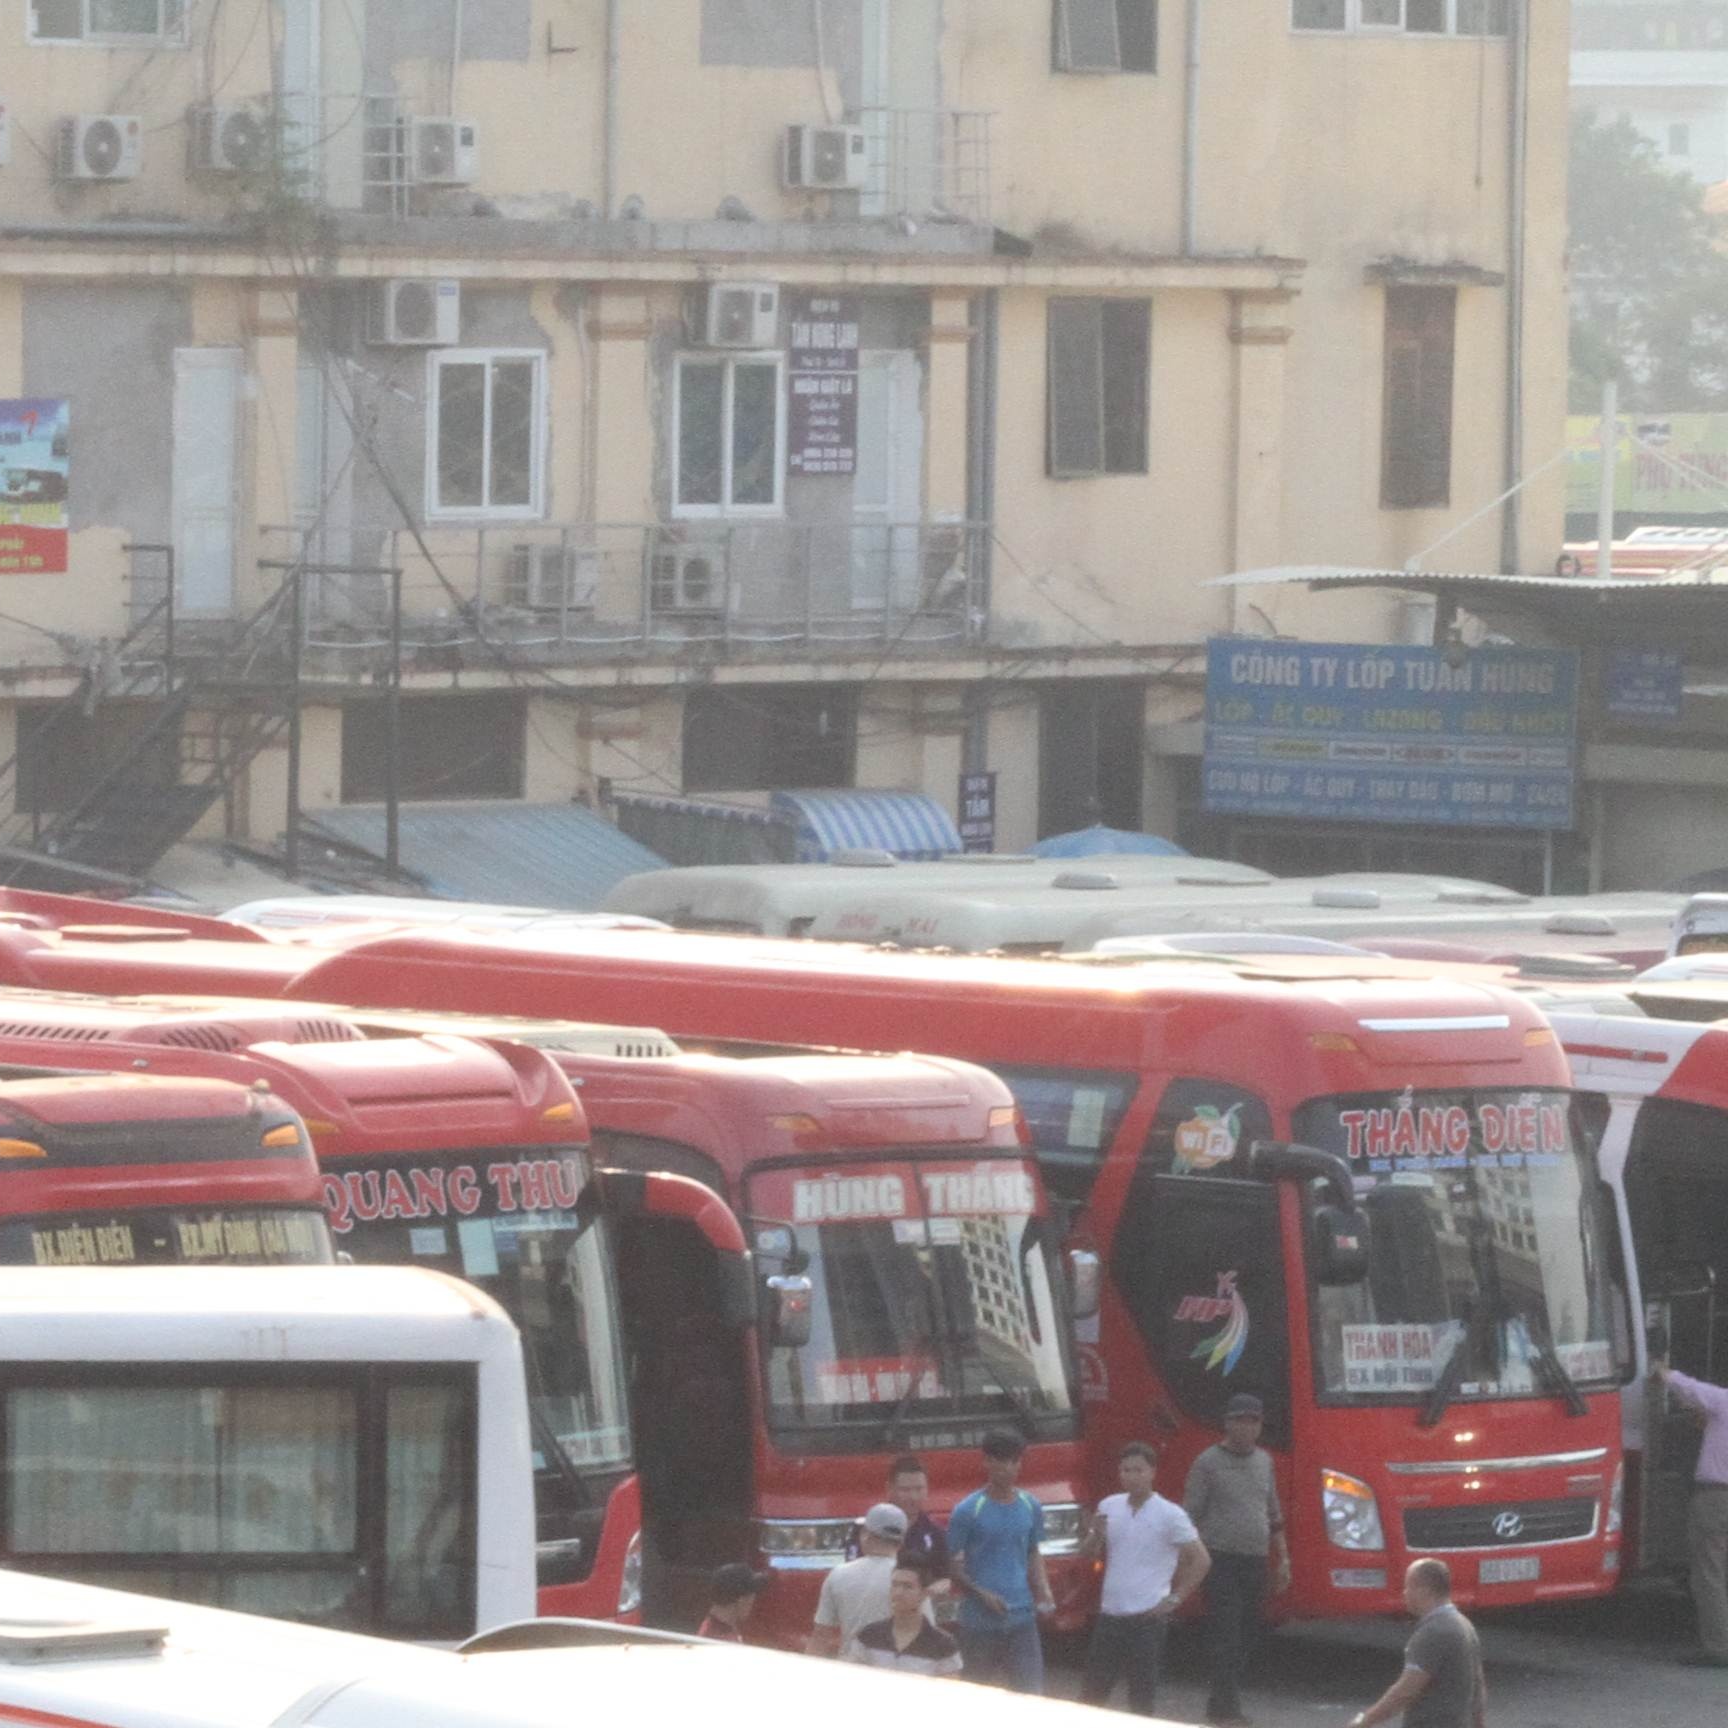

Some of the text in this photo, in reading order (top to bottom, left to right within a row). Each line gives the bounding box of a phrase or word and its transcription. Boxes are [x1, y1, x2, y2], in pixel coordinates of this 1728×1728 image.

[1230, 648, 1301, 687] CÔNG
[1308, 657, 1340, 688] TY
[316, 1159, 579, 1234] QUANG THU
[792, 1171, 906, 1222] HÙNG
